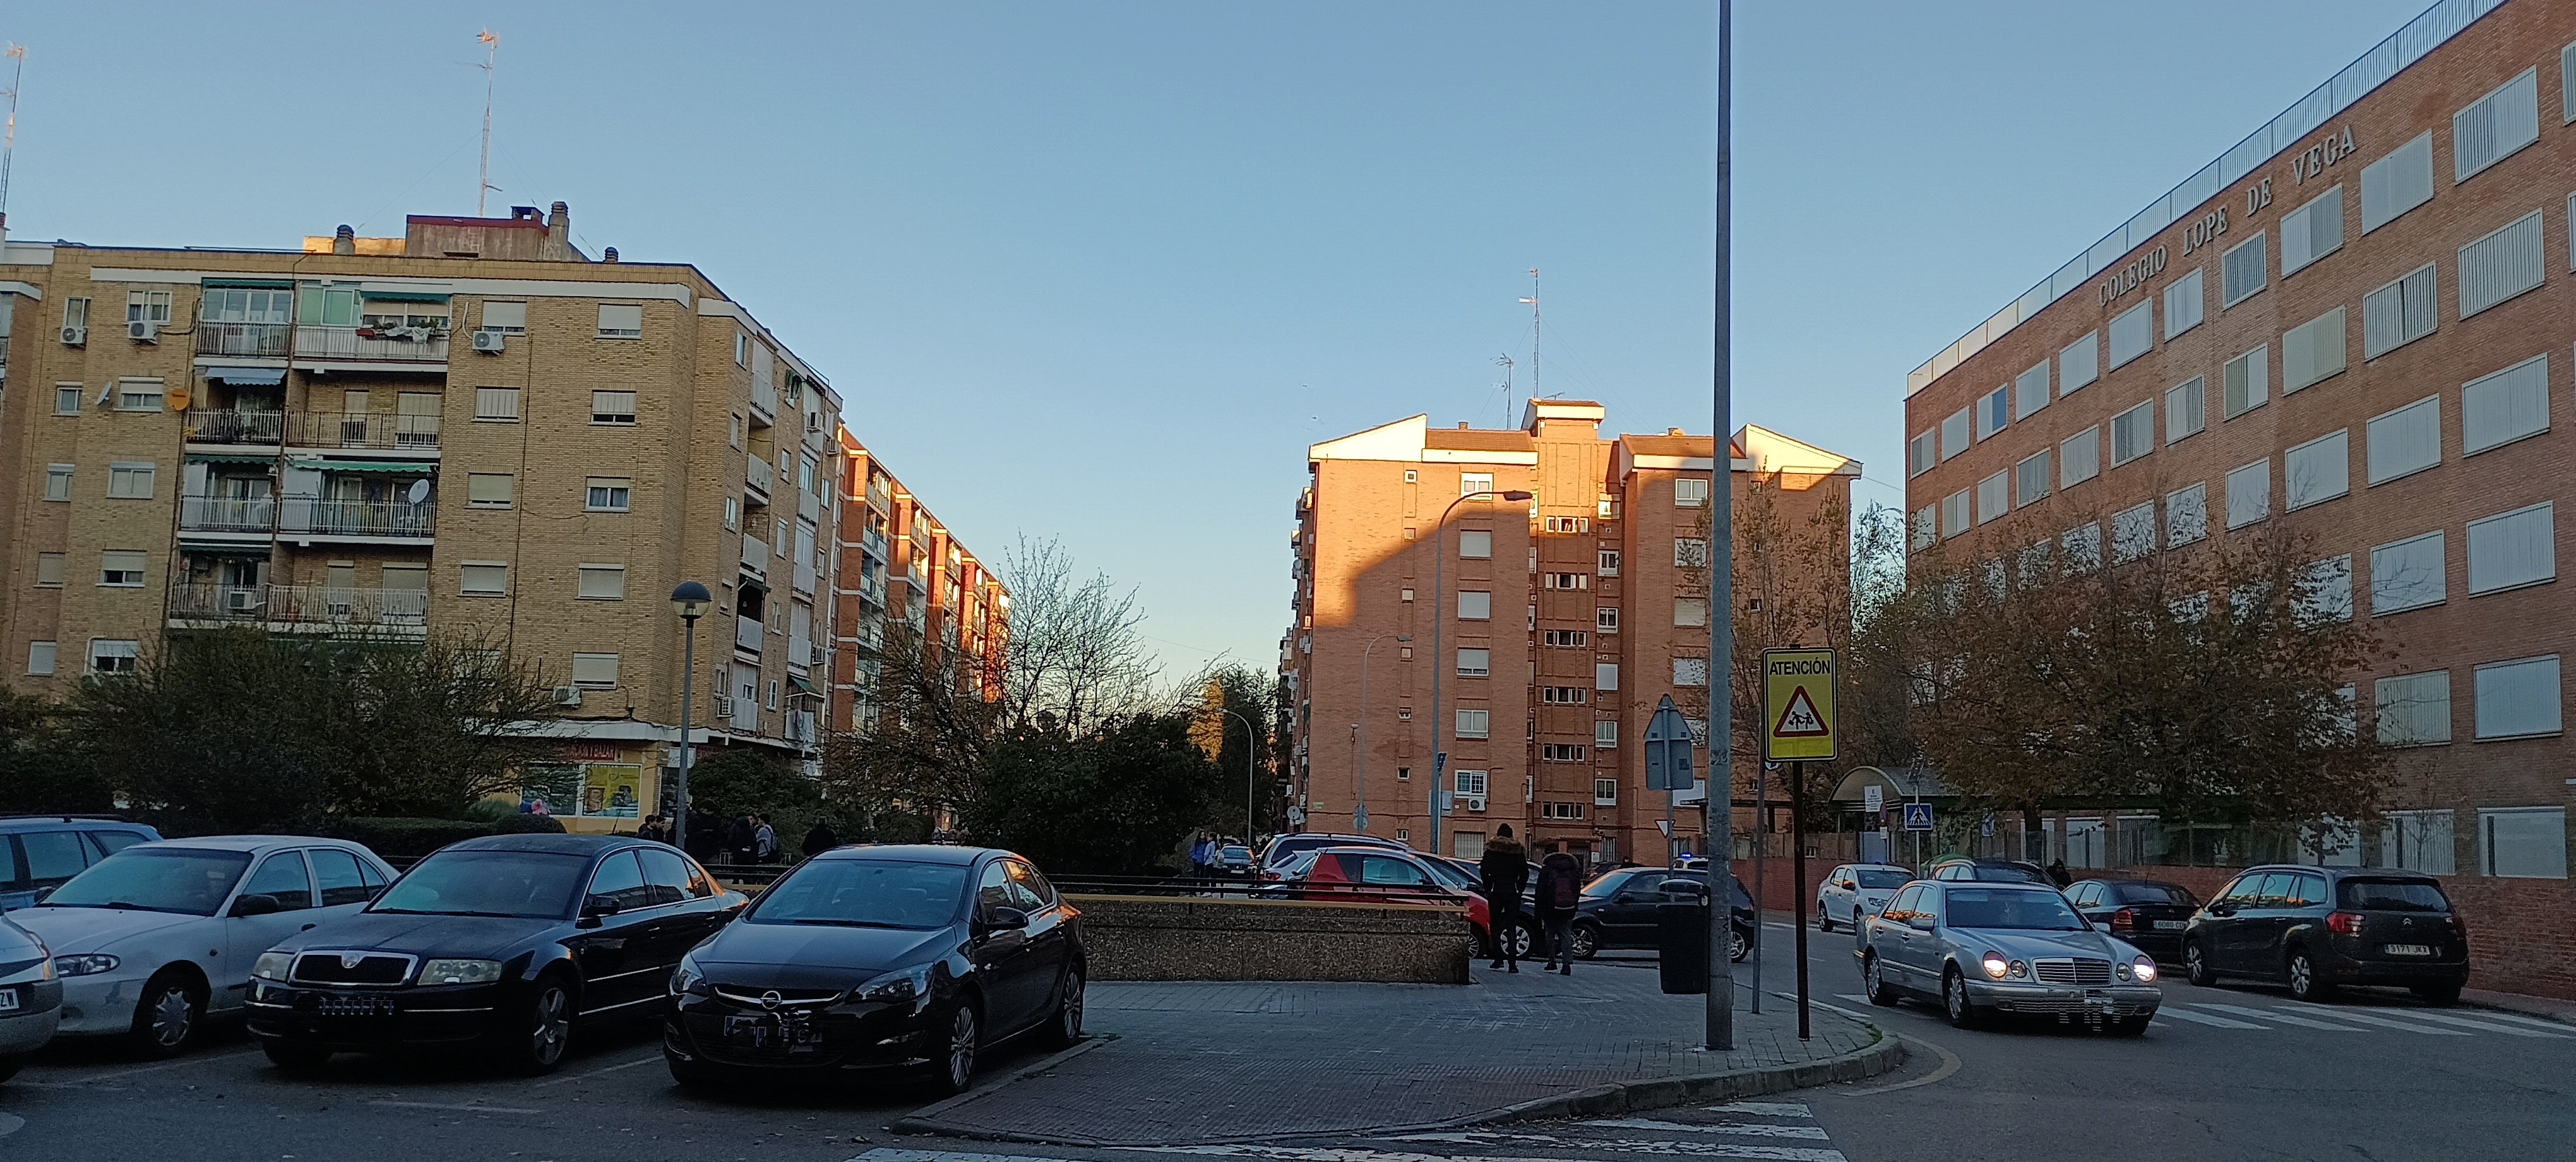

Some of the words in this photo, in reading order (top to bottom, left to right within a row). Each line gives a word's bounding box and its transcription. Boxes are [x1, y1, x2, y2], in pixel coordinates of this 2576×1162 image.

[2098, 244, 2168, 308] COLEGIO
[2183, 204, 2229, 257] LOPE
[2246, 175, 2273, 217] DE
[2290, 125, 2357, 185] VEGA
[1769, 657, 1830, 675] ATENCIÓN
[594, 744, 615, 758] BAZAR
[2390, 945, 2410, 953] 3171
